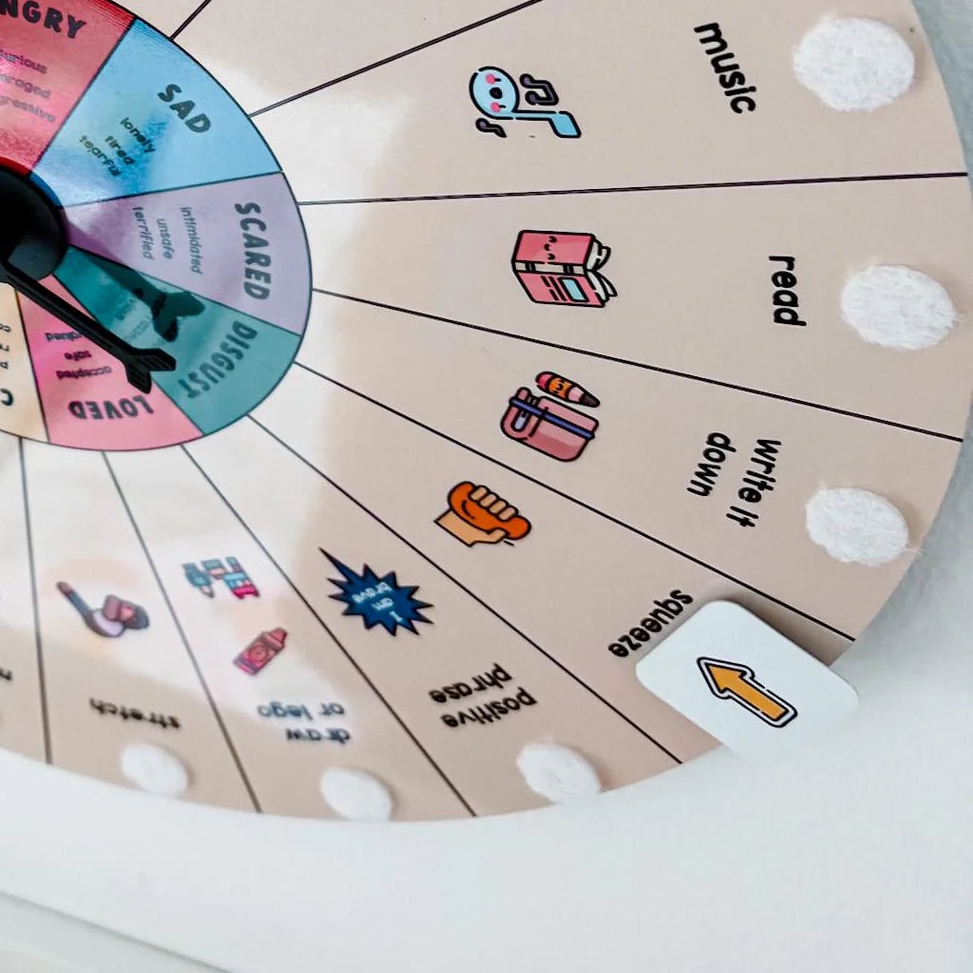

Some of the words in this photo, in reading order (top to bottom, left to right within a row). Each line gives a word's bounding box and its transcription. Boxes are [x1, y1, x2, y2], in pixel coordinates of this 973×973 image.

[694, 22, 757, 114] music
[158, 83, 211, 134] SAD
[104, 135, 136, 165] tired
[119, 117, 155, 153] lonely
[78, 135, 121, 178] tearful
[132, 206, 154, 260] terrified
[156, 218, 174, 260] unsafe
[181, 207, 203, 275] intimidated
[235, 202, 274, 300] SCARED
[769, 255, 806, 327] read
[55, 366, 111, 380] accepted
[64, 349, 92, 360] safe
[178, 321, 258, 400] DISGUST
[68, 395, 154, 420] LOVED
[687, 432, 736, 496] down
[738, 439, 782, 503] write
[726, 506, 759, 527] it
[351, 582, 397, 608] brave
[608, 589, 693, 657] squeeze
[429, 663, 513, 703] phrase
[89, 698, 181, 729] stretch
[257, 701, 313, 720] lego
[320, 703, 344, 715] or
[441, 687, 538, 727] positive
[285, 728, 350, 744] draw
